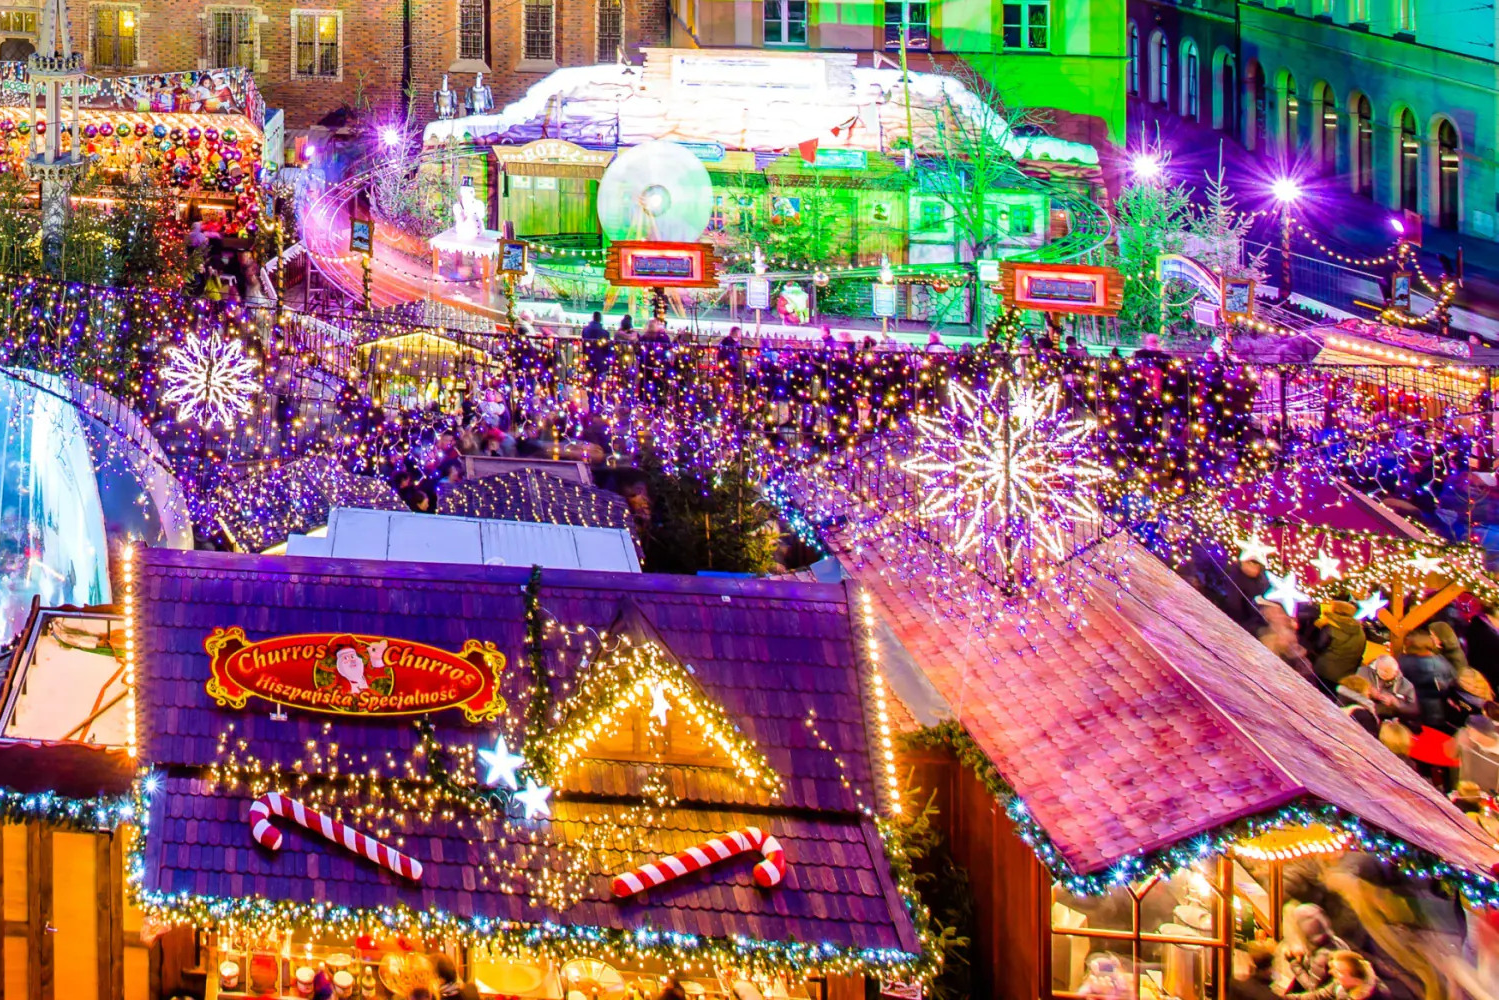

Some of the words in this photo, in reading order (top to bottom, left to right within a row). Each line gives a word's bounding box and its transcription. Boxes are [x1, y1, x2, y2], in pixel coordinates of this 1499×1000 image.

[521, 142, 581, 162] HOTEL
[238, 643, 327, 674] Churros
[383, 645, 476, 686] Churros
[255, 672, 352, 706] Hiszpańska
[357, 684, 457, 711] Specjalność
